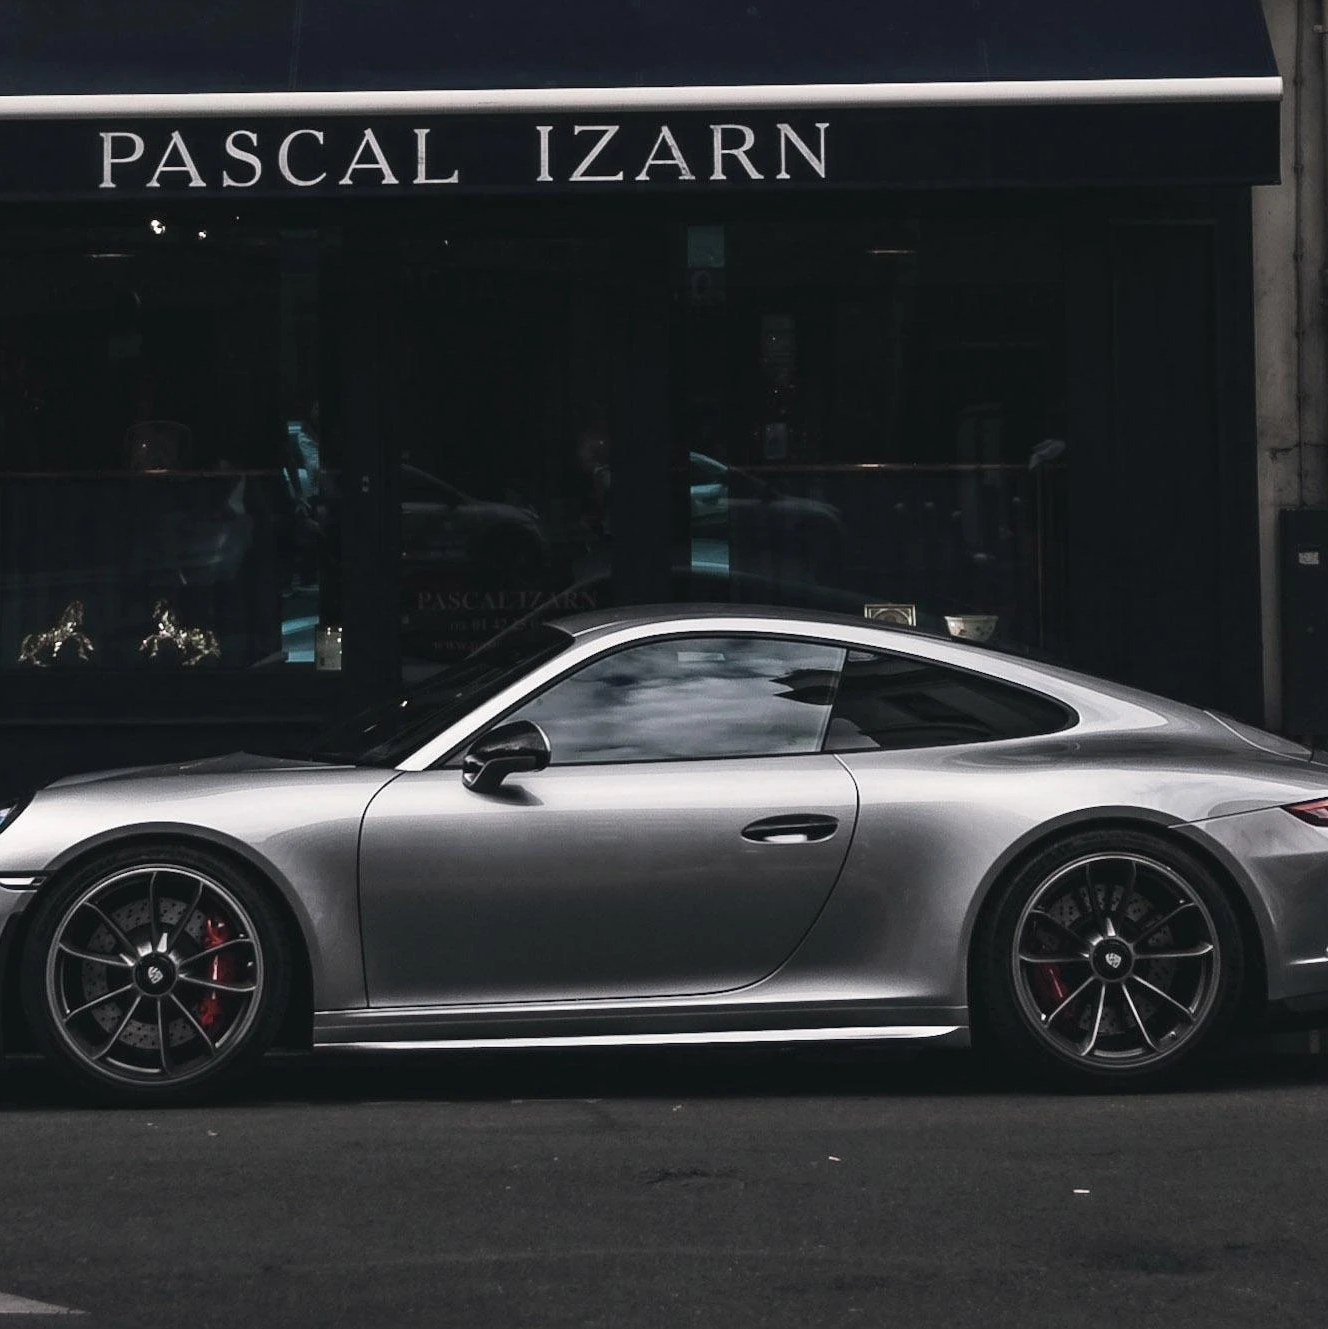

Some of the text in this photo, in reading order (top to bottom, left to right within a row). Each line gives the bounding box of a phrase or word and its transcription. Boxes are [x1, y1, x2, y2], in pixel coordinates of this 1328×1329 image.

[100, 123, 829, 188] PASCAL IZARN
[417, 591, 598, 610] PASCAL IZARN
